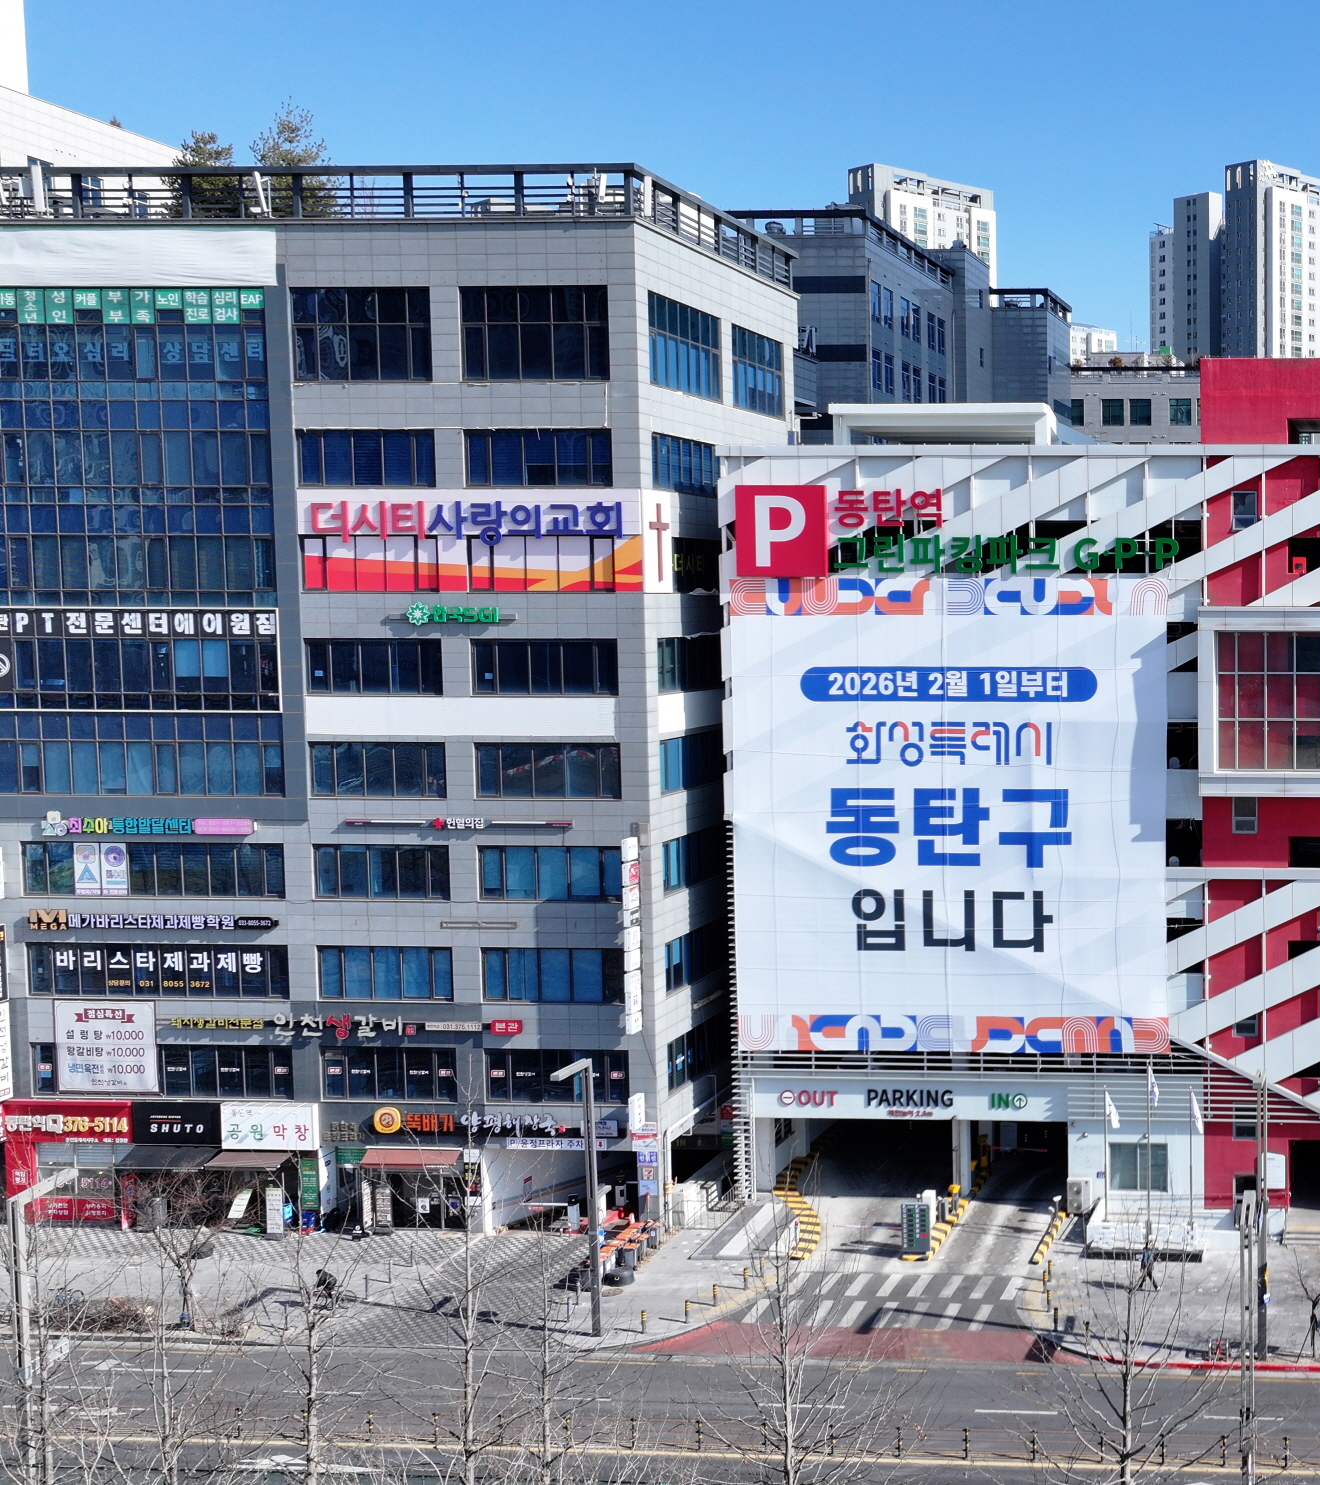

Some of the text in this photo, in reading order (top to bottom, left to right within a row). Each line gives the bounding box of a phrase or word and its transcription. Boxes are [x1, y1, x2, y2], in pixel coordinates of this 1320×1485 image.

[23, 290, 38, 323] 청소년
[51, 290, 67, 323] 성인
[75, 292, 98, 306] 커플
[107, 290, 124, 323] 부부
[134, 290, 151, 323] 가족
[157, 293, 179, 306] 노인
[185, 291, 209, 305] 학습
[213, 291, 236, 305] 심리
[240, 294, 263, 305] EAP
[186, 308, 210, 321] 진로
[214, 308, 238, 321] 검사
[834, 488, 944, 527] 동탄역
[753, 494, 806, 568] P
[834, 534, 1060, 574] 그린파킹파크
[432, 605, 499, 623] 한국SGI
[827, 670, 1069, 698] 2026년 2월 1일부터
[845, 720, 1053, 767] 화성특례시
[68, 817, 192, 834] 최수아 통합발달센터
[446, 817, 484, 829] 헌혈의집
[825, 787, 1073, 869] 동탄구
[30, 923, 68, 931] MEGA
[68, 913, 236, 930] 메가바리스타제과제빵학원
[851, 888, 1054, 953] 입니다
[86, 1009, 123, 1019] 점심특선
[273, 1012, 404, 1040] 인천생갈비
[494, 1022, 519, 1033] 본관
[67, 1046, 104, 1057] 왕갈비탕
[799, 1090, 838, 1106] OUT
[867, 1089, 954, 1108] PARKING
[990, 1093, 1010, 1109] IN
[5, 1115, 128, 1132] 동탄역 376-5114
[150, 1124, 205, 1134] SHUTO
[406, 1113, 454, 1132] 뚝배기
[520, 1139, 564, 1149] 윤정프라자
[567, 1139, 585, 1149] 주차
